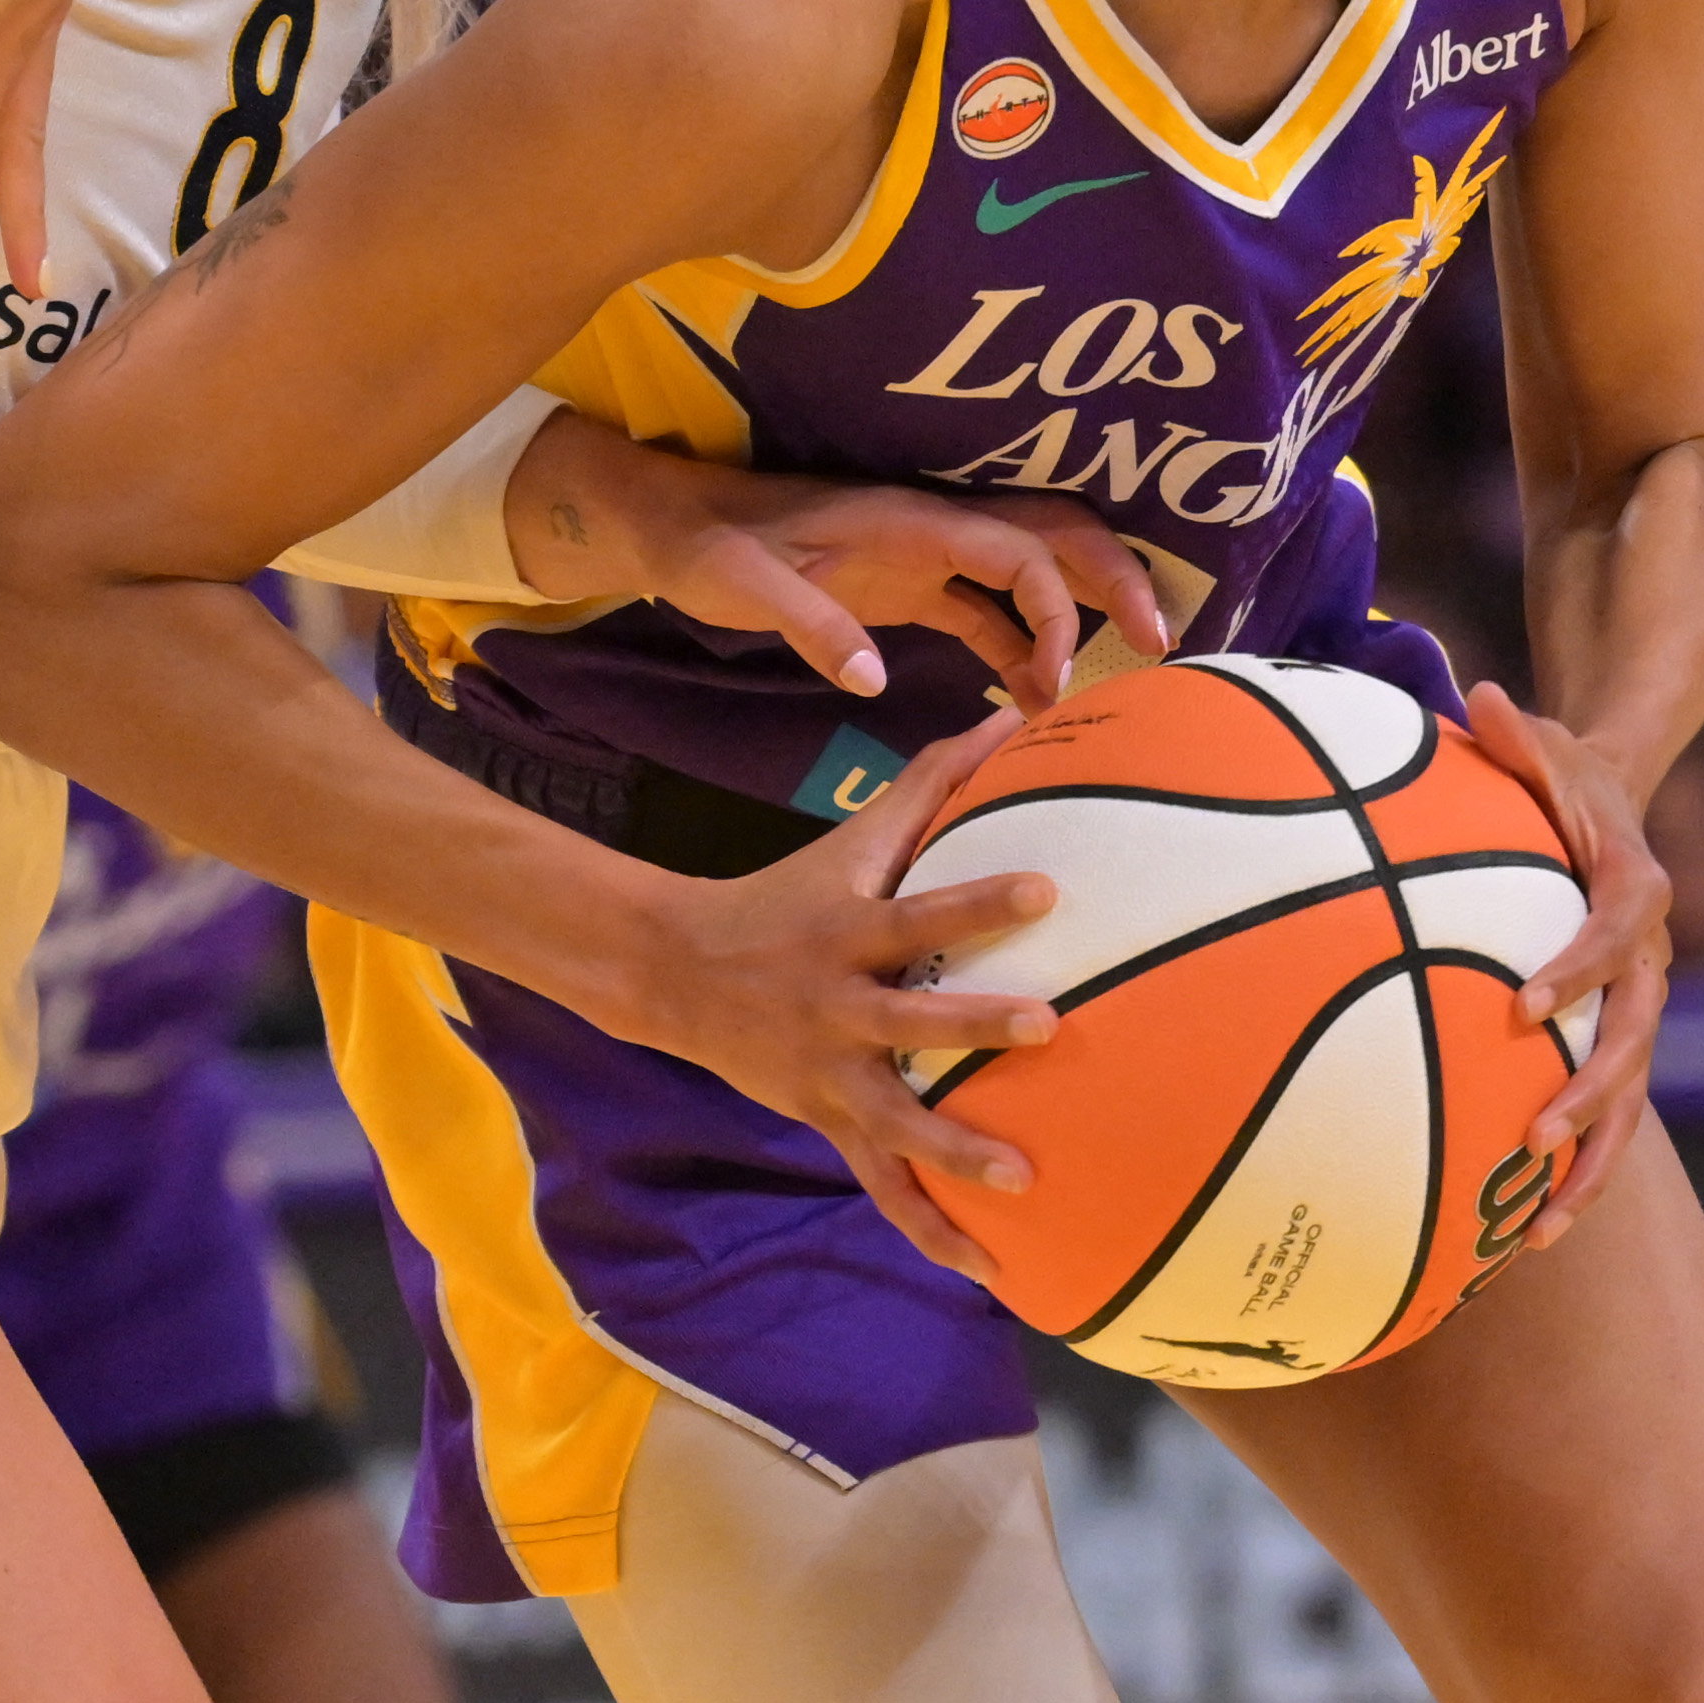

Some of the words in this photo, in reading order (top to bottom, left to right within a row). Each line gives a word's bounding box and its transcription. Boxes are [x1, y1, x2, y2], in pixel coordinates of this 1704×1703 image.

[1405, 12, 1550, 112] Albert
[884, 285, 1244, 399] LOS
[1267, 1223, 1322, 1311] OFFICIAL
[1269, 1203, 1308, 1268] GAME
[1239, 1270, 1278, 1317] BALL
